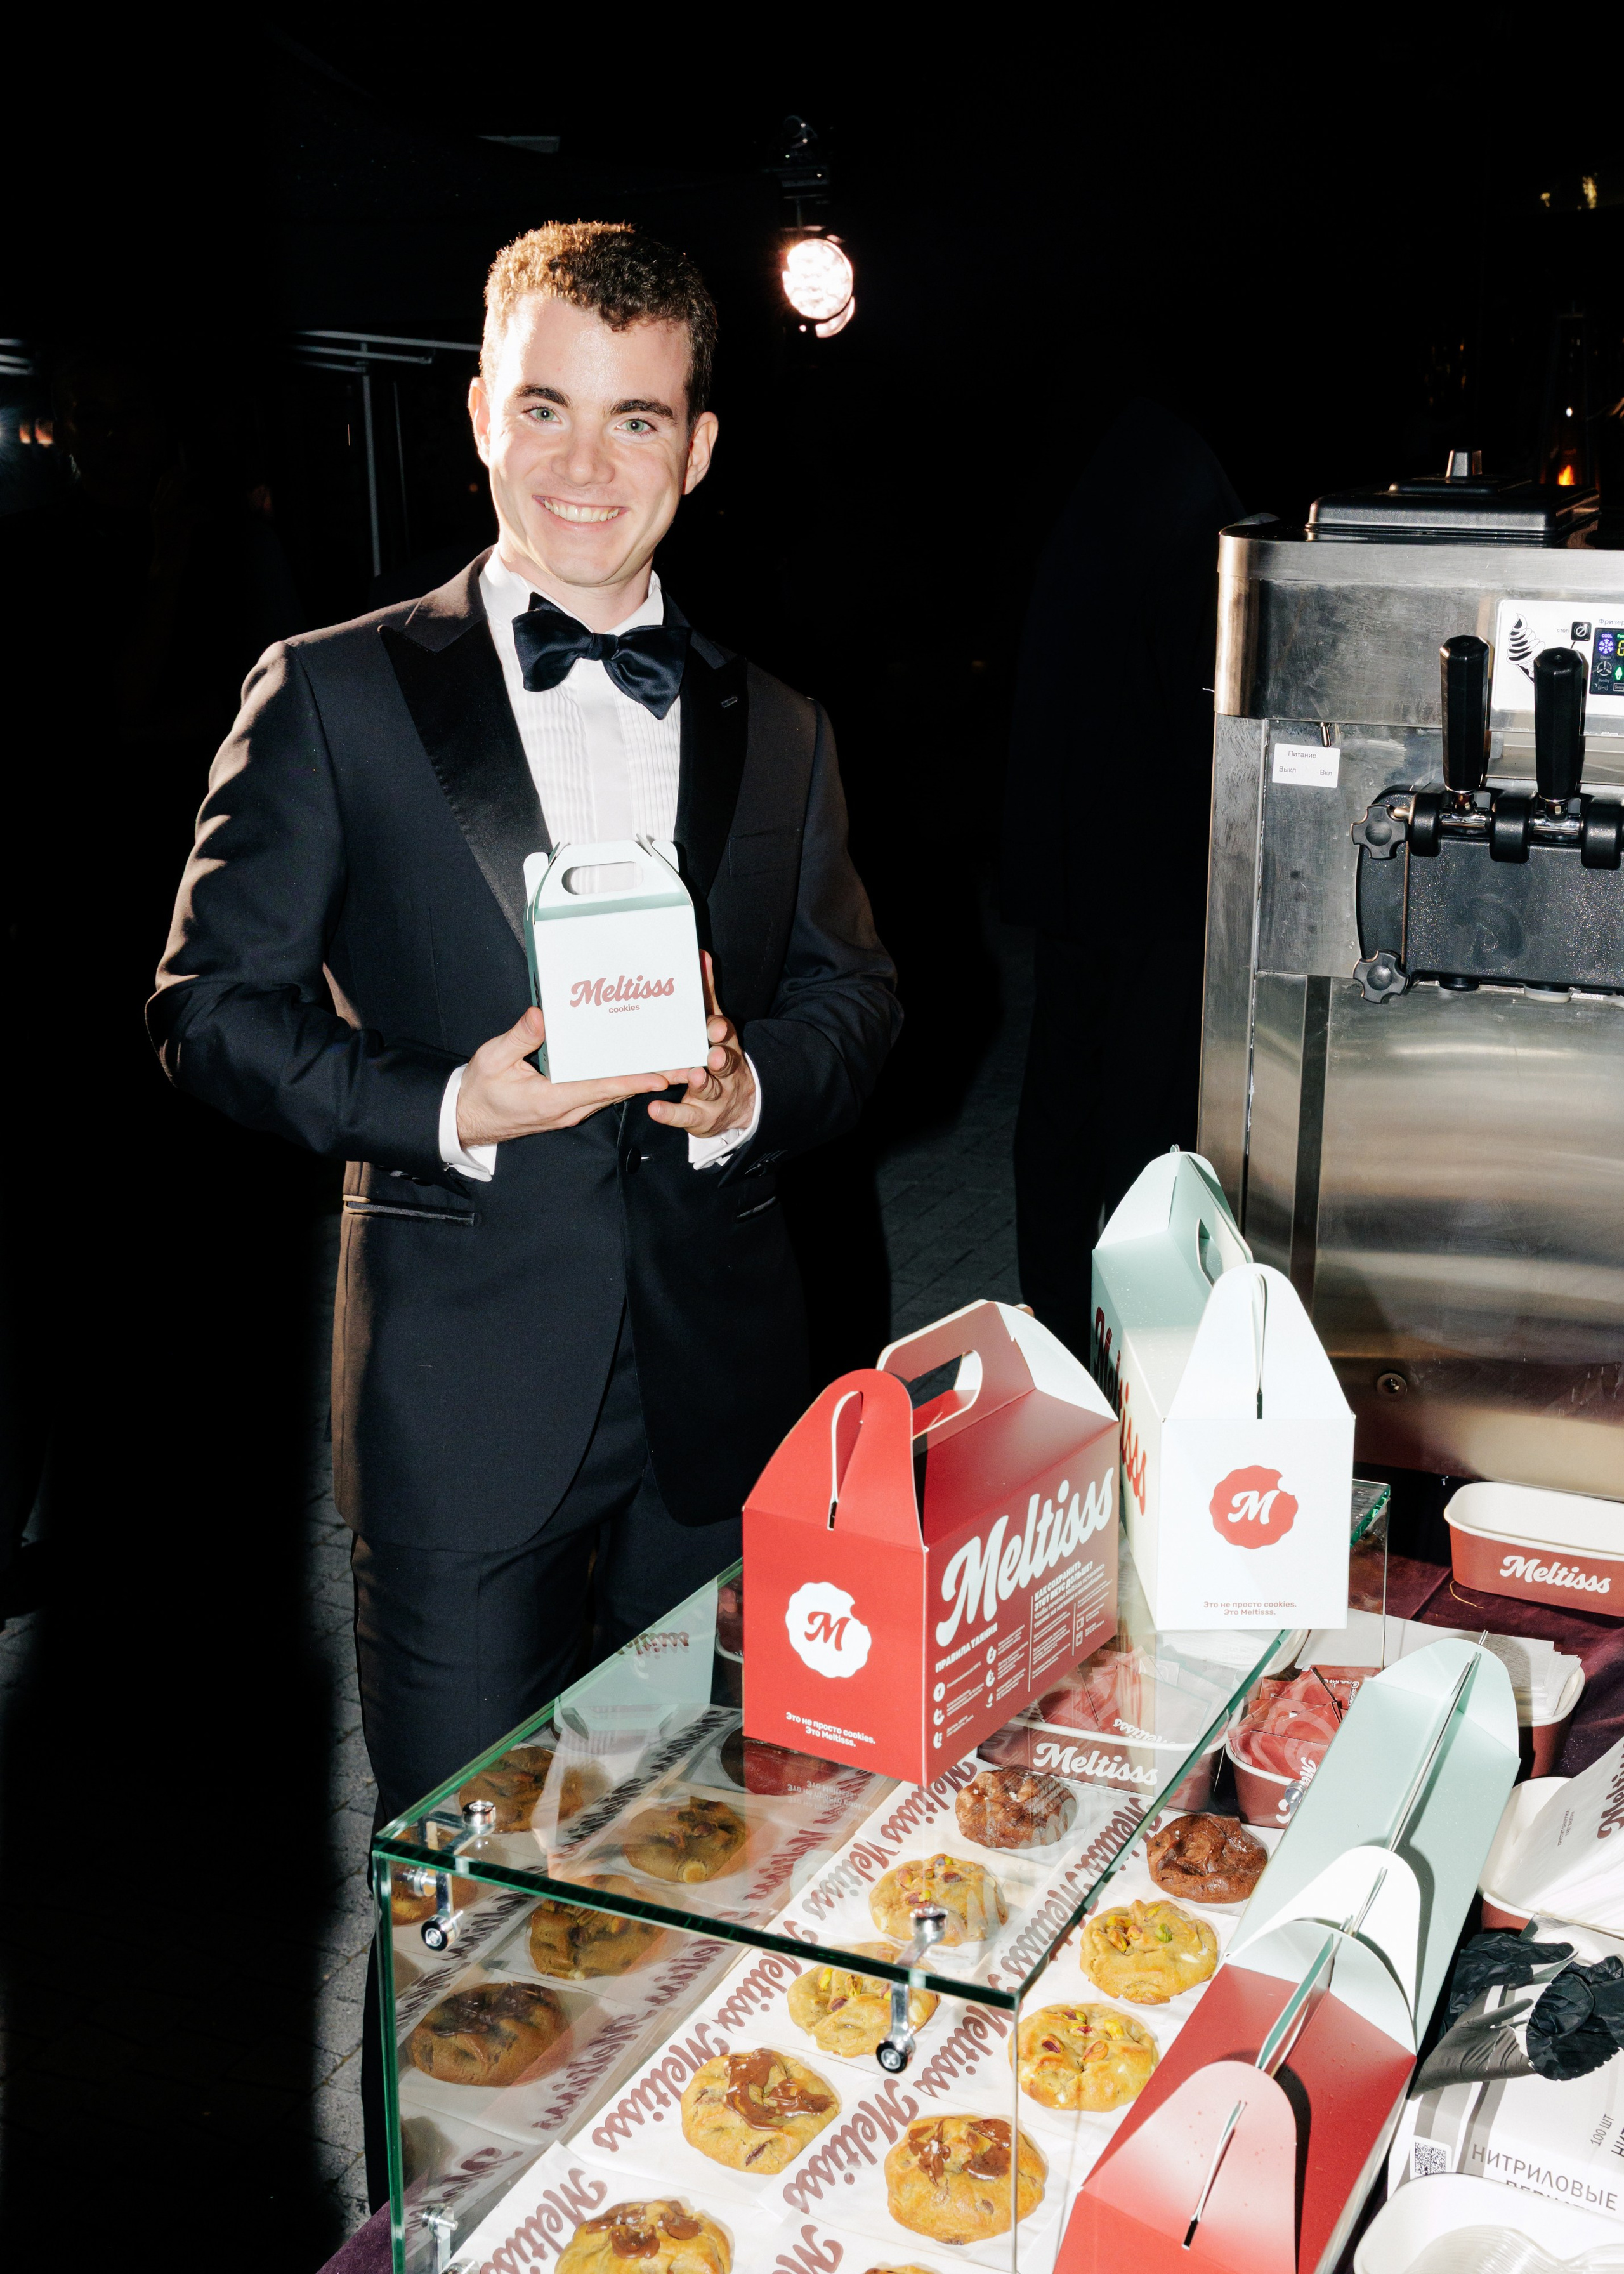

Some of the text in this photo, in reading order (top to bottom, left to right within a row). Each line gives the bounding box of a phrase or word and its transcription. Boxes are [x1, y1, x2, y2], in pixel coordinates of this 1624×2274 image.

[1288, 750, 1316, 759] Питание
[570, 975, 674, 1008] Meltisss
[608, 1004, 640, 1013] cookies
[1228, 1490, 1280, 1525] M
[935, 1467, 1114, 1648] Meltisss
[1500, 1555, 1611, 1594] Meltisss
[1034, 1594, 1049, 1612] ЭТОТ
[1050, 1584, 1066, 1601] ВКУС
[1035, 1586, 1047, 1601] КАК
[804, 1611, 851, 1652] M
[935, 1642, 971, 1673] ПРАВИЛА
[786, 1712, 875, 1744] Это не просто cookies.
[806, 1726, 856, 1747] Это Meltisss.
[1033, 1742, 1158, 1786] Meltisss
[592, 2023, 730, 2153] Meltisss
[1590, 2113, 1614, 2146] 100 ШТ
[783, 2079, 919, 2214] Meltisss
[1472, 2143, 1618, 2211] НИТРИЛОВЫЕ
